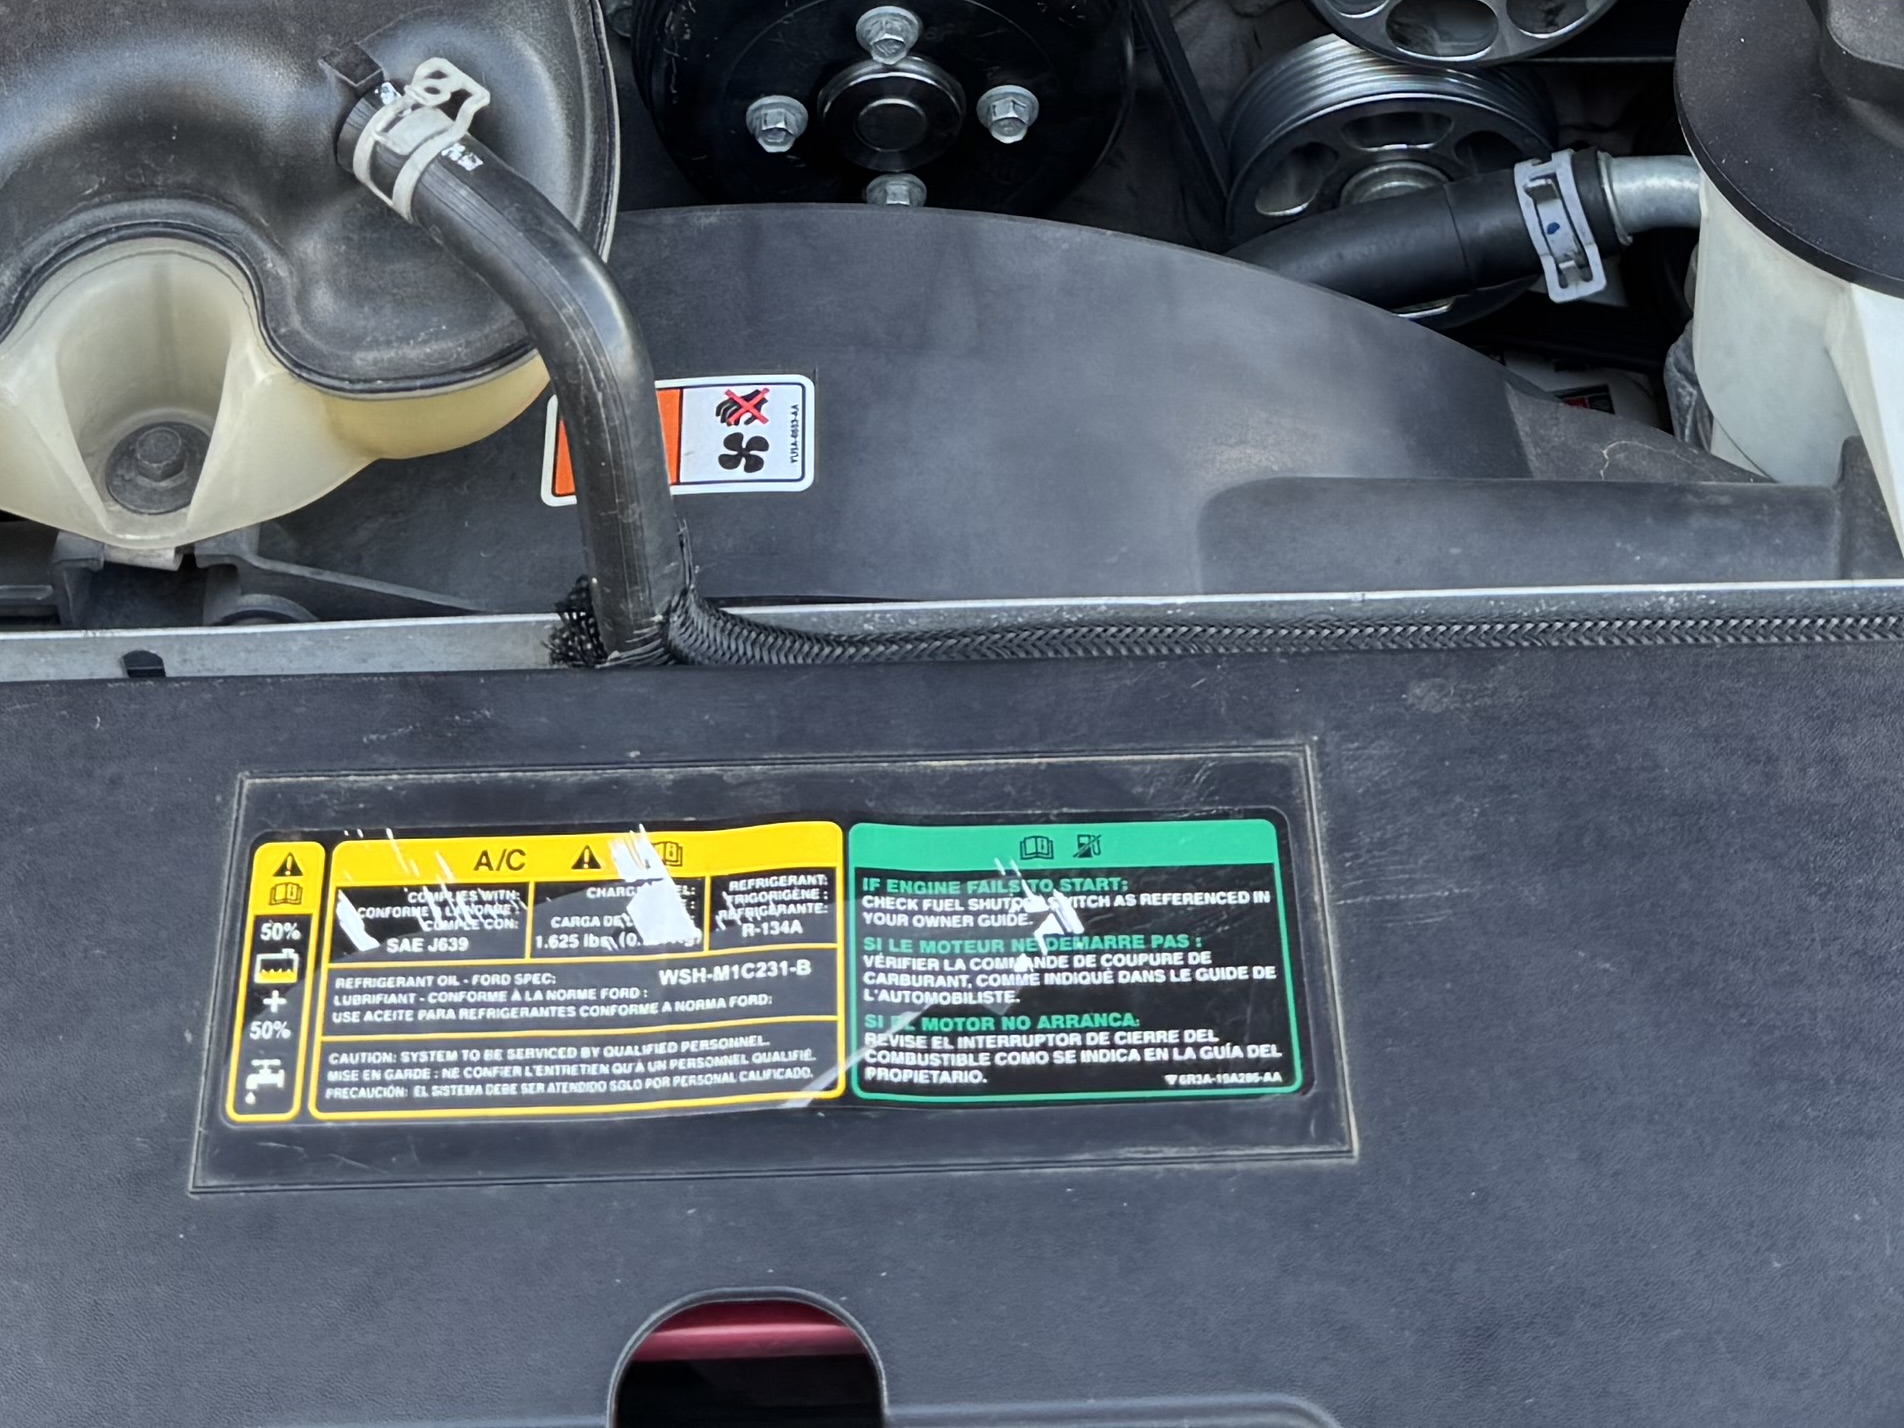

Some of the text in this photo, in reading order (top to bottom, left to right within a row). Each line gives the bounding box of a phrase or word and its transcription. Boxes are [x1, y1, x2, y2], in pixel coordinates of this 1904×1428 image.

[473, 847, 527, 873] A/C
[586, 886, 649, 899] CHARG
[728, 874, 828, 891] REFRIGERANT:
[861, 877, 882, 892] IF
[886, 878, 962, 895] ENGINE
[966, 878, 1022, 895] FAILS
[1028, 877, 1055, 894] TO
[861, 889, 1271, 912] CHECK FUEL AS REFERENCED IN
[550, 915, 601, 929] CARGA
[741, 920, 804, 938] R-134A
[861, 911, 1035, 929] YOUR OWNER GUIDE.
[259, 921, 303, 942] 50%
[386, 935, 470, 953] SAE J639
[535, 935, 580, 950] 1.625
[862, 933, 1191, 955] SI LE MOTEUR NE PAS
[861, 949, 1213, 972] VÉRIFIER LA DE COUPURE DE
[334, 972, 557, 990] REFRIGERANT OIL FORD SPEC:
[659, 958, 813, 987] WSH-M1C231-B
[862, 972, 973, 989] CARBURANT,
[975, 972, 1041, 988] COMME
[1117, 968, 1167, 984] DANS
[1169, 968, 1192, 982] LE
[1195, 966, 1250, 982] GUIDE
[1252, 965, 1277, 980] DE
[333, 992, 417, 1007] LUBRIFIANT
[427, 990, 508, 1004] CONFORME
[524, 989, 545, 1002] LA
[548, 988, 596, 1002] NORME
[600, 986, 641, 1000] FORD
[862, 988, 1022, 1006] L'AUTOMOBILISTE.
[332, 993, 774, 1024] USE ACEITE PARA REFRIGERANTES CONFORME A NORMA FORD:
[249, 1020, 292, 1040] 50%
[864, 1013, 884, 1029] SI
[920, 1015, 996, 1032] MOTOR
[1000, 1015, 1032, 1031] NO
[1036, 1012, 1141, 1031] ARRANCA:
[864, 1028, 1220, 1050] REVISE EL INTERRUPTOR DE CIERRE DEL
[327, 1034, 772, 1066] CAUTION: SYSTEM TO BE SERVICED BY QUALIFIED PERSONNEL.
[864, 1041, 1284, 1067] COMBUSTIBLE COMO SE INDICA EN LA GUÍA DEL
[327, 1069, 360, 1083] MISE
[362, 1068, 382, 1082] EN
[384, 1066, 432, 1082] GARDE
[441, 1066, 461, 1080] NE
[463, 1064, 523, 1079] CONFIER
[647, 1059, 668, 1073] UN
[669, 1053, 750, 1072] PERSONNEL
[864, 1066, 989, 1084] PROPIETARIO.
[412, 1085, 430, 1098] EL
[431, 1083, 484, 1098] SISTEMA
[484, 1082, 519, 1097] DEBE
[520, 1081, 546, 1095] SER
[546, 1079, 608, 1094] ATENDIDO
[644, 1075, 671, 1091] POR
[672, 1070, 737, 1089] PERSONAL
[739, 1066, 815, 1084] CALIFICADO.
